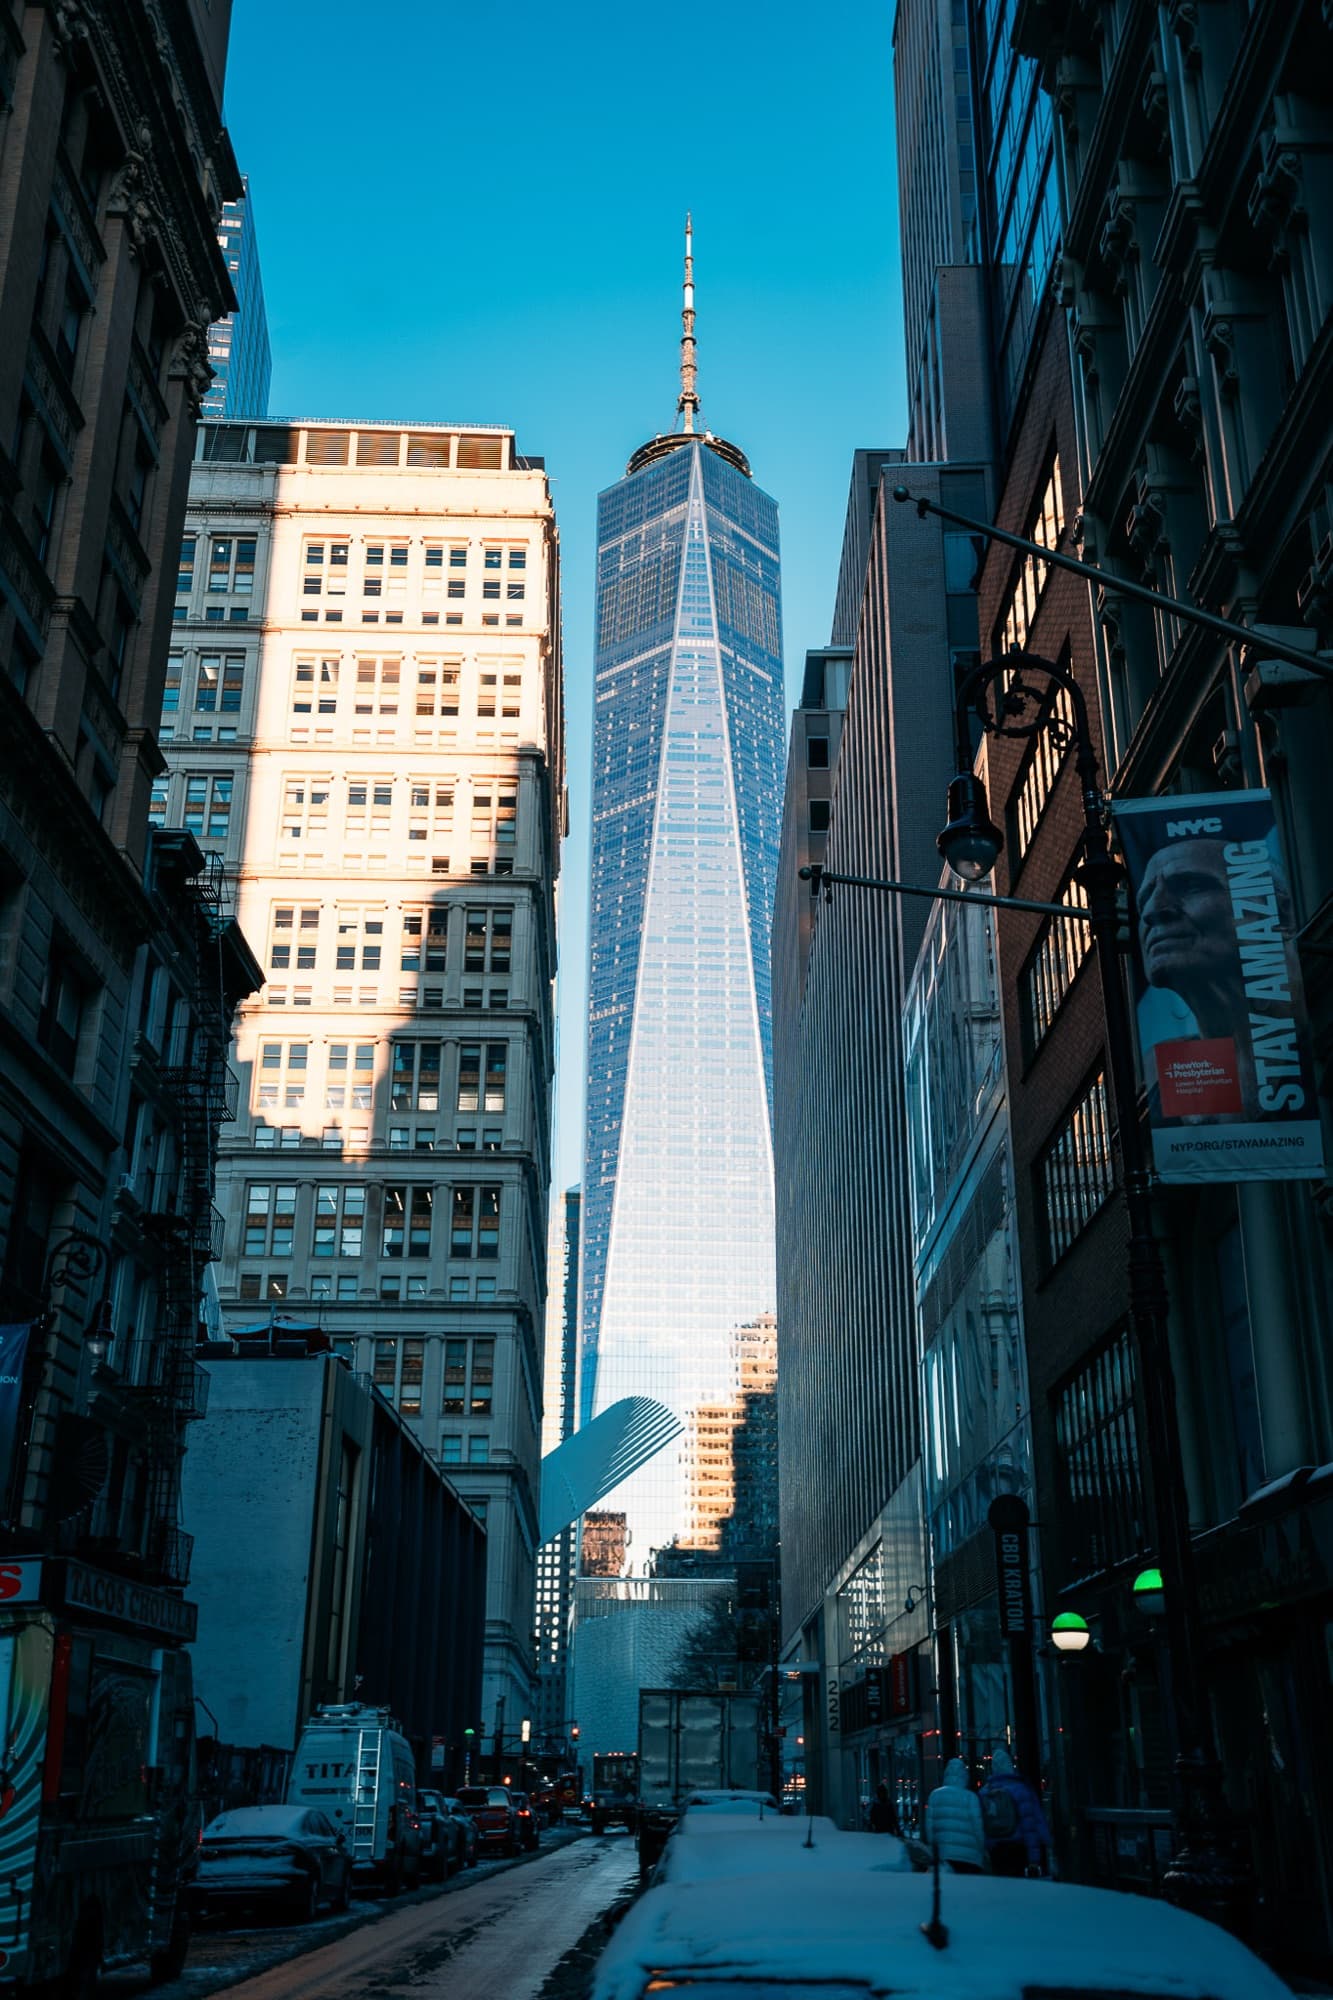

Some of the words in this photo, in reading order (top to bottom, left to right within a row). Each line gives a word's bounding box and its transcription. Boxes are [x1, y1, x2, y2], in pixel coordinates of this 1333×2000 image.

[1166, 816, 1223, 838] NYC
[1223, 839, 1293, 1002] AMAZING
[1248, 1012, 1305, 1112] STAY
[1170, 1136, 1305, 1153] NYP.ORG/STAYAMAZING
[1001, 1533, 1020, 1564] CBD
[71, 1567, 126, 1615] TACOS
[1003, 1568, 1025, 1632] KRATOM
[828, 1680, 839, 1732] 222
